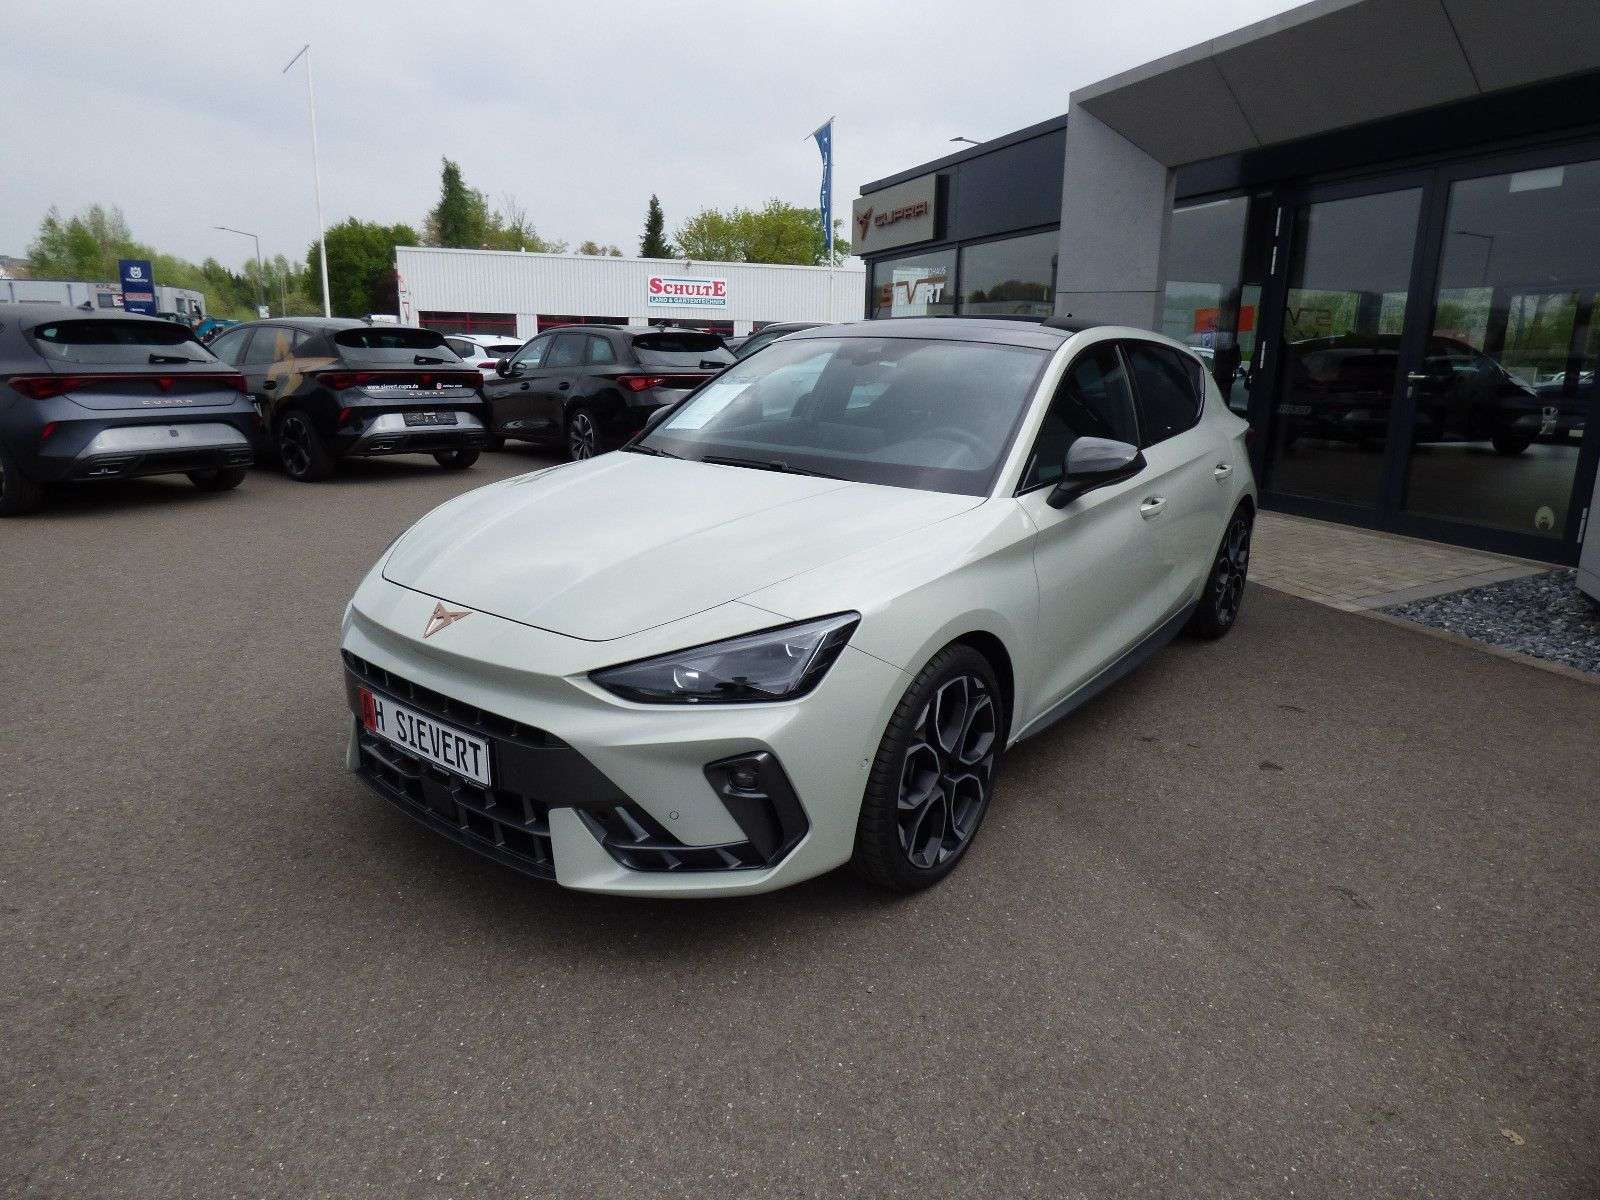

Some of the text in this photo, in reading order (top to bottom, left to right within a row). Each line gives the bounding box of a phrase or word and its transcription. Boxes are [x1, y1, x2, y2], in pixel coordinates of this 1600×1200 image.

[875, 201, 928, 226] CUPRA
[649, 277, 727, 297] SCHULTE
[374, 698, 481, 776] H SIEVERT
